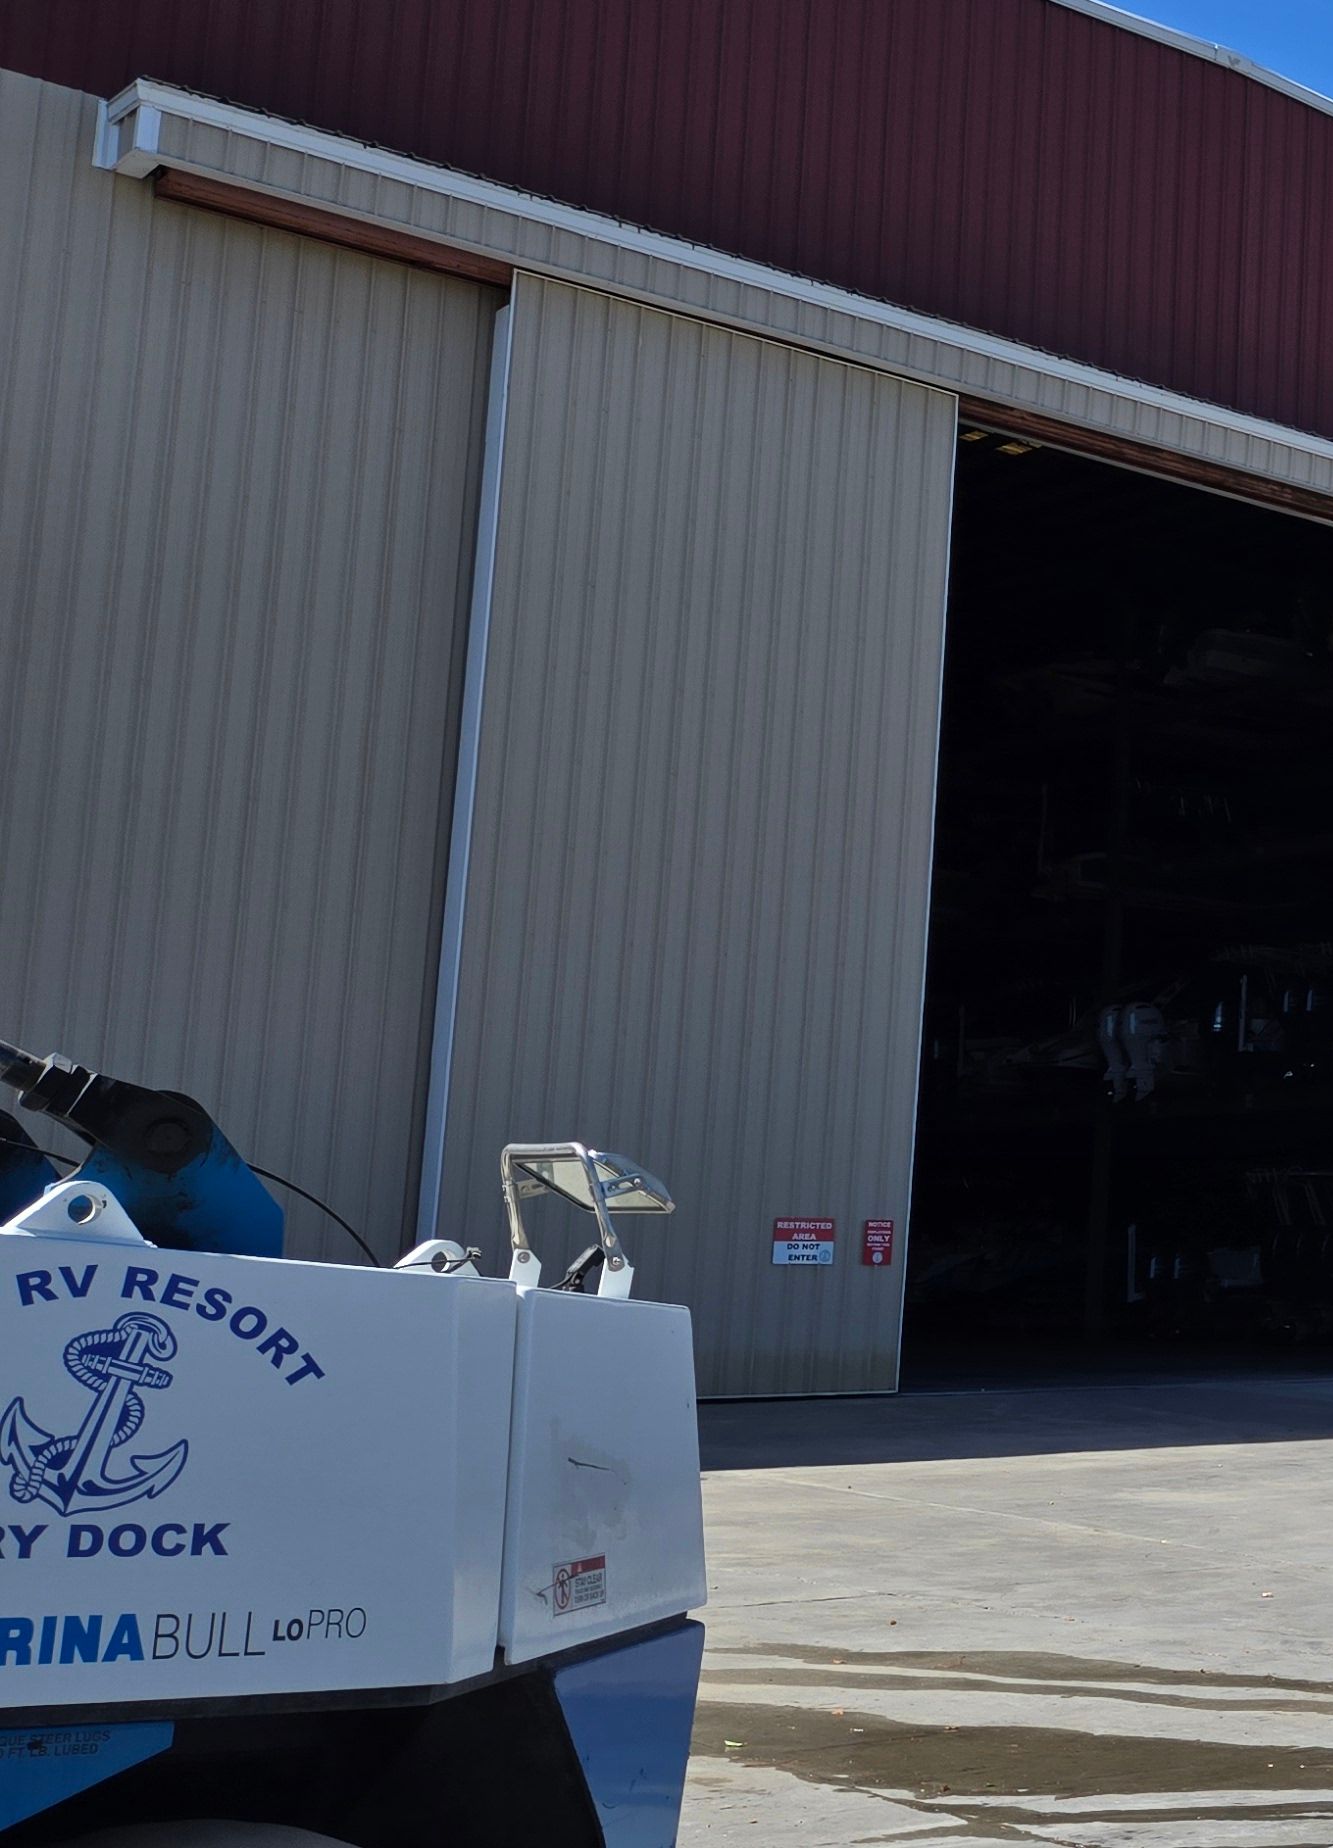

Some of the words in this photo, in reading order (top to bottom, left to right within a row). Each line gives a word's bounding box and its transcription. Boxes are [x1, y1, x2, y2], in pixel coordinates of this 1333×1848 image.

[777, 1221, 832, 1229] RESTRICTED
[16, 1264, 98, 1306] RV
[120, 1265, 326, 1386] RESORT
[0, 1524, 49, 1559] Y
[66, 1522, 232, 1558] DOCK
[75, 1730, 111, 1743] LUGS
[54, 1743, 98, 1756] LUBED
